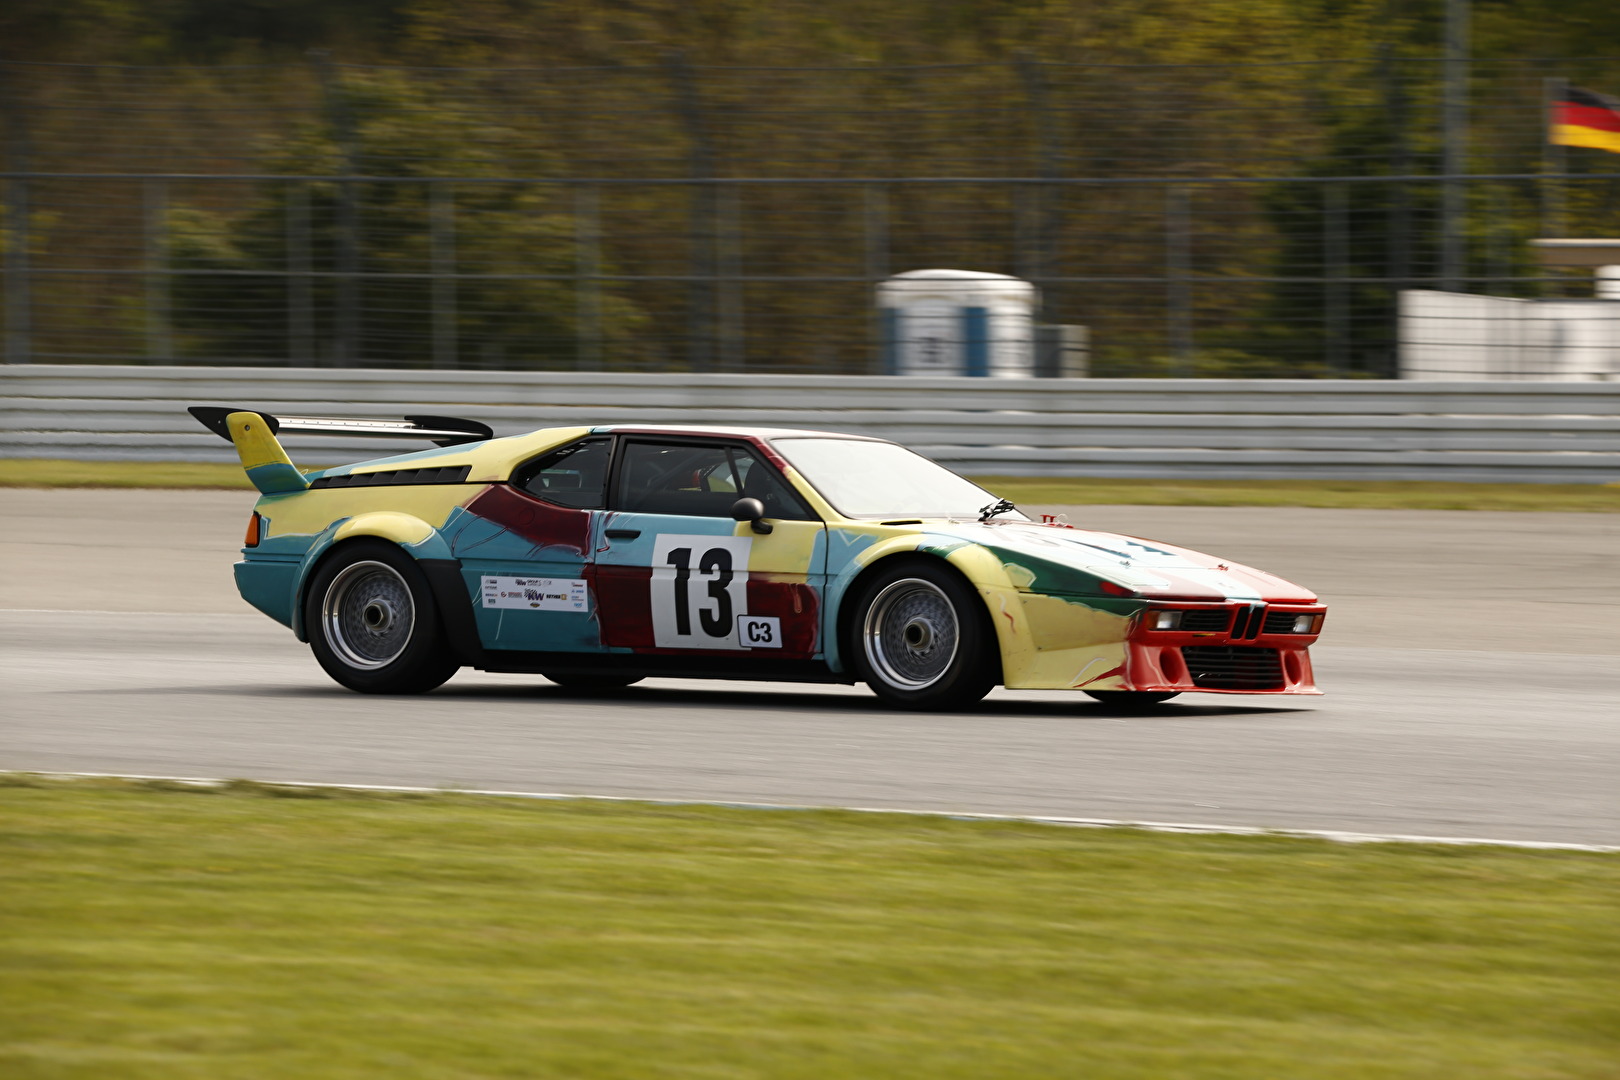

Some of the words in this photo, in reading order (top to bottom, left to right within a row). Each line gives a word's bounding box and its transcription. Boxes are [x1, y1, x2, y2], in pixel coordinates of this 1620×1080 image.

[528, 592, 545, 601] KW
[667, 547, 733, 638] 13
[748, 621, 773, 642] C3
